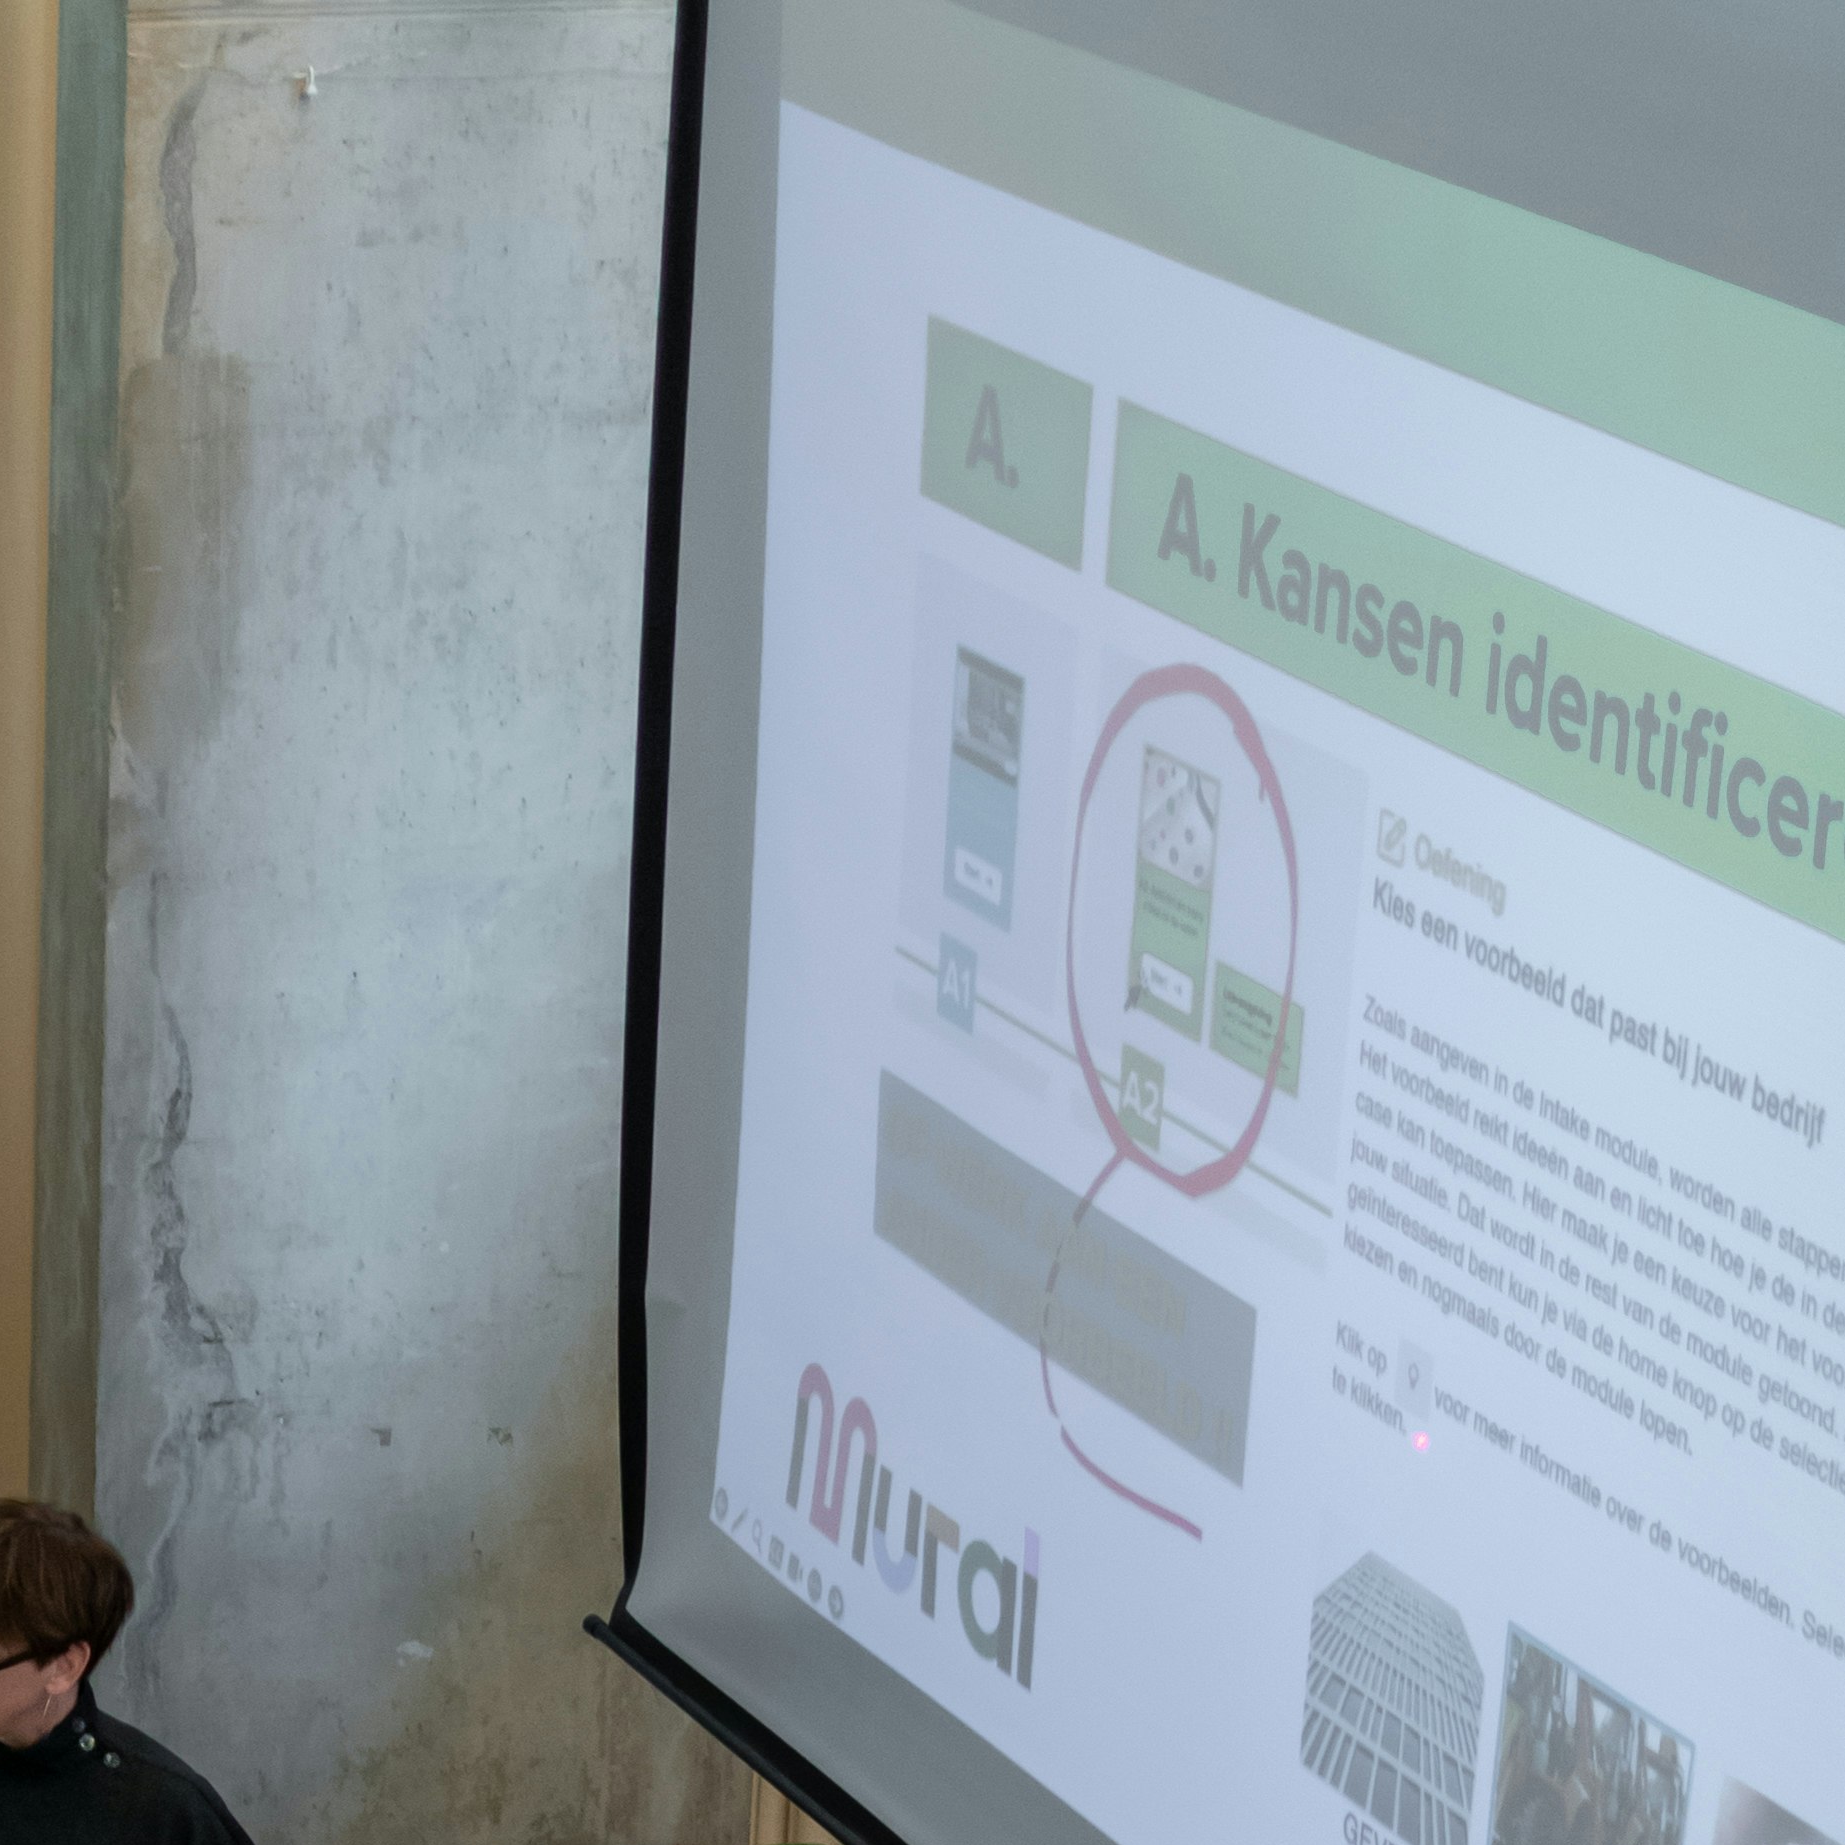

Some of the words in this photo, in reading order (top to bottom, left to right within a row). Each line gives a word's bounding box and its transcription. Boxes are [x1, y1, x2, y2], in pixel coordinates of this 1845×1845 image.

[964, 385, 1019, 489] A.
[1157, 473, 1217, 583] A.
[1237, 502, 1464, 697] Kansen
[1485, 611, 1845, 870] identificer
[1413, 833, 1507, 917] Oefening
[1122, 1071, 1159, 1128] A2
[1361, 992, 1407, 1041] Zoals
[1409, 1022, 1490, 1085] aangeven
[1494, 1062, 1509, 1099] in
[1512, 1078, 1535, 1112] de
[1538, 1091, 1591, 1140] Intake
[1595, 1126, 1663, 1186] module,
[1669, 1164, 1736, 1223] worden
[1741, 1204, 1773, 1243] alle
[1372, 875, 1416, 930] Kies
[1420, 909, 1459, 952] een
[1464, 931, 1567, 1007] voorbeeld
[1571, 982, 1605, 1030] dat
[1609, 1008, 1657, 1055] past
[1662, 1026, 1689, 1082] bij
[1691, 1043, 1747, 1103] jouw
[1751, 1070, 1825, 1149] bedrijf
[1350, 1131, 1388, 1174] jouw
[1391, 1157, 1451, 1213] situatie.
[1457, 1190, 1487, 1234] Dat
[1490, 1216, 1536, 1262] wordt
[1539, 1238, 1555, 1273] in
[1558, 1255, 1581, 1287] de
[1585, 1272, 1619, 1312] rest
[1623, 1293, 1655, 1331] van
[1658, 1312, 1681, 1346] de
[1686, 1331, 1754, 1388] module
[1355, 1090, 1393, 1130] case
[1396, 1106, 1426, 1149] kan
[1429, 1127, 1517, 1203] toepassen.
[1522, 1179, 1559, 1223] Hier
[1561, 1208, 1608, 1252] maak
[1611, 1232, 1629, 1267] je
[1633, 1249, 1667, 1287] een
[1671, 1265, 1726, 1320] keuze
[1730, 1302, 1772, 1346] voor
[1776, 1323, 1807, 1368] het
[1359, 1039, 1387, 1080] Het
[1391, 1061, 1470, 1123] voorbeeld
[1474, 1105, 1509, 1146] reikt
[1573, 1164, 1606, 1203] aan
[1610, 1184, 1633, 1217] en
[1637, 1194, 1673, 1242] licht
[1678, 1217, 1706, 1257] toe
[1710, 1234, 1745, 1277] hoe
[1748, 1258, 1767, 1295] je
[1772, 1273, 1796, 1307] de
[1800, 1286, 1818, 1320] in
[1332, 1363, 1348, 1398] te
[1350, 1375, 1408, 1438] klikken.
[1343, 1220, 1395, 1276] kiezen
[1397, 1260, 1419, 1292] en
[1421, 1274, 1501, 1341] nogmaals
[1503, 1321, 1543, 1366] door
[1545, 1345, 1567, 1380] de
[1571, 1364, 1635, 1421] module
[1639, 1398, 1694, 1458] lopen.
[1346, 1181, 1466, 1270] geïnteresseerd
[1468, 1245, 1505, 1293] bent
[1508, 1270, 1539, 1313] kun
[1541, 1290, 1558, 1330] je
[1562, 1306, 1588, 1345] via
[1592, 1323, 1615, 1357] de
[1618, 1334, 1668, 1388] home
[1672, 1366, 1718, 1421] knop
[1721, 1402, 1747, 1439] op
[1750, 1415, 1775, 1450] de
[1335, 1319, 1365, 1362] Klik
[1366, 1344, 1388, 1380] op
[1434, 1384, 1470, 1427] voor
[1473, 1409, 1516, 1454] meer
[1519, 1433, 1603, 1510] informatie
[1605, 1496, 1646, 1537] over
[1648, 1518, 1673, 1555] de
[1677, 1535, 1797, 1633] voorbeelden.
